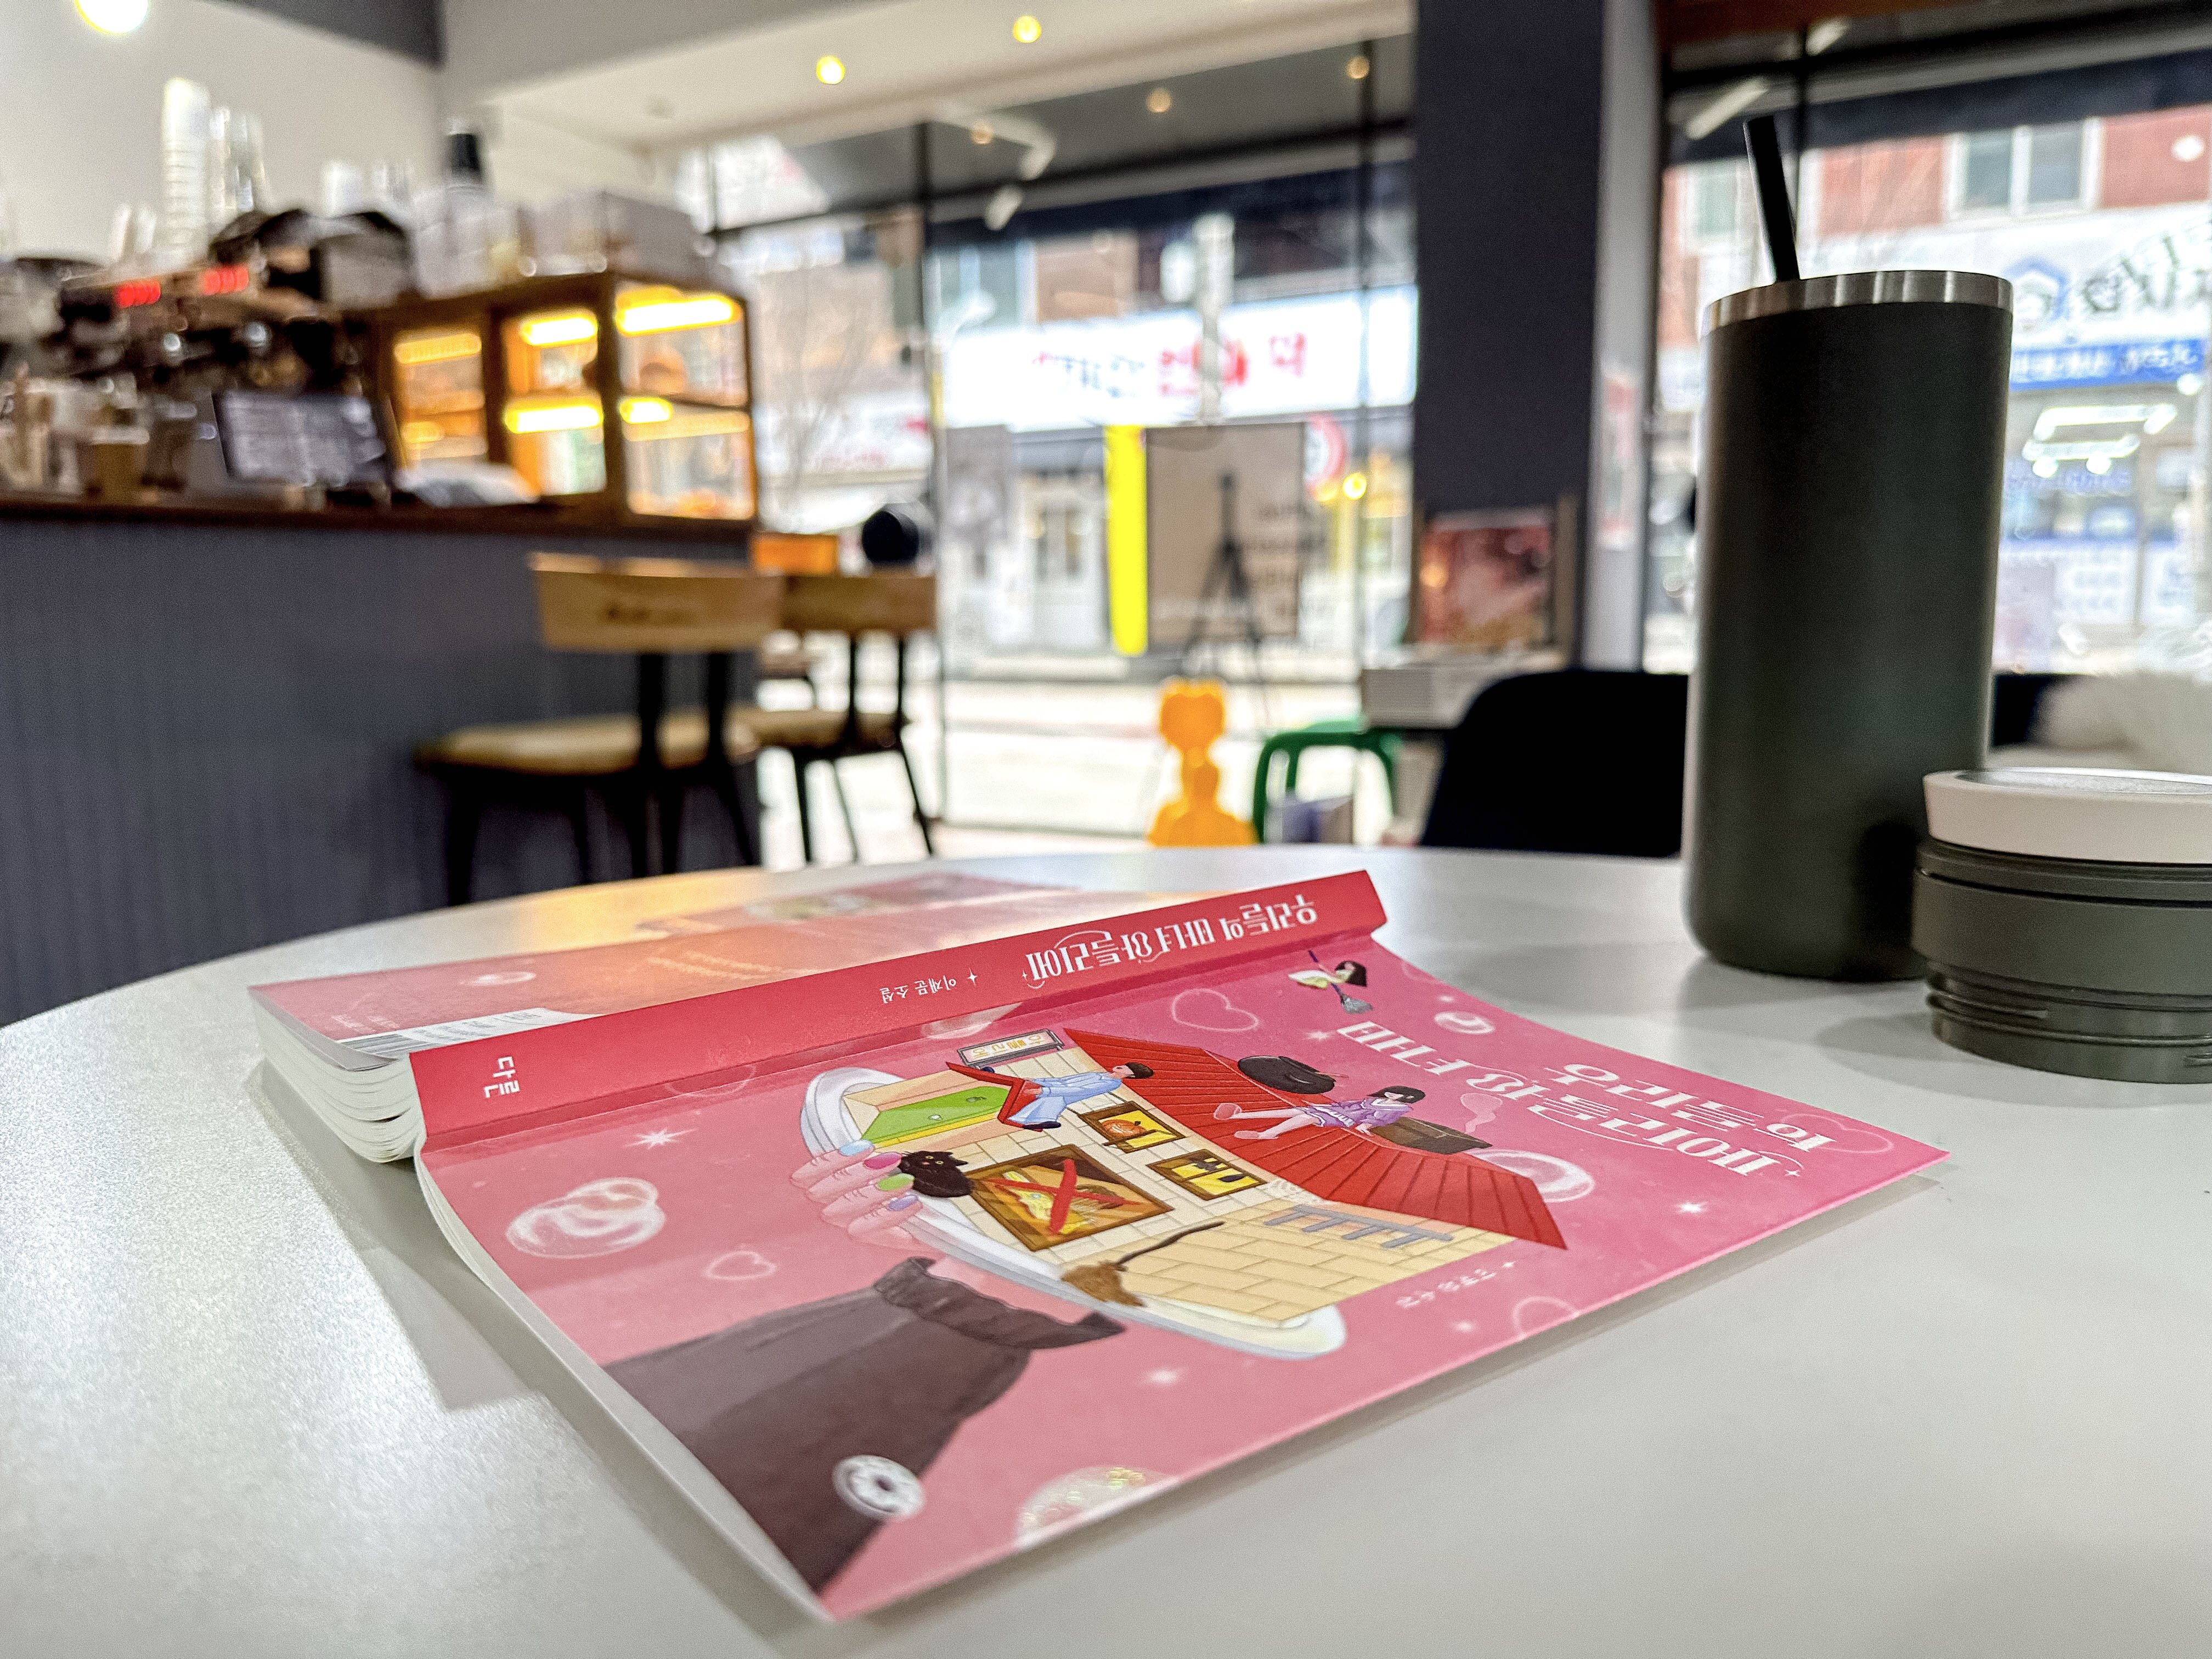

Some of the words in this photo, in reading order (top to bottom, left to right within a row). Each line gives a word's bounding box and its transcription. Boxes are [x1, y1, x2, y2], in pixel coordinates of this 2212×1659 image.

[1154, 918, 1216, 953] 마녀
[1220, 894, 1317, 940] 우리들의
[1025, 931, 1153, 981] 아틀리에
[879, 985, 909, 1004] 소설
[915, 975, 956, 996] 이재문
[483, 1057, 520, 1098] 다른
[1337, 1020, 1472, 1075] 마녀
[1465, 1073, 1784, 1177] 아틀리에
[1544, 1063, 1837, 1152] 우리들의
